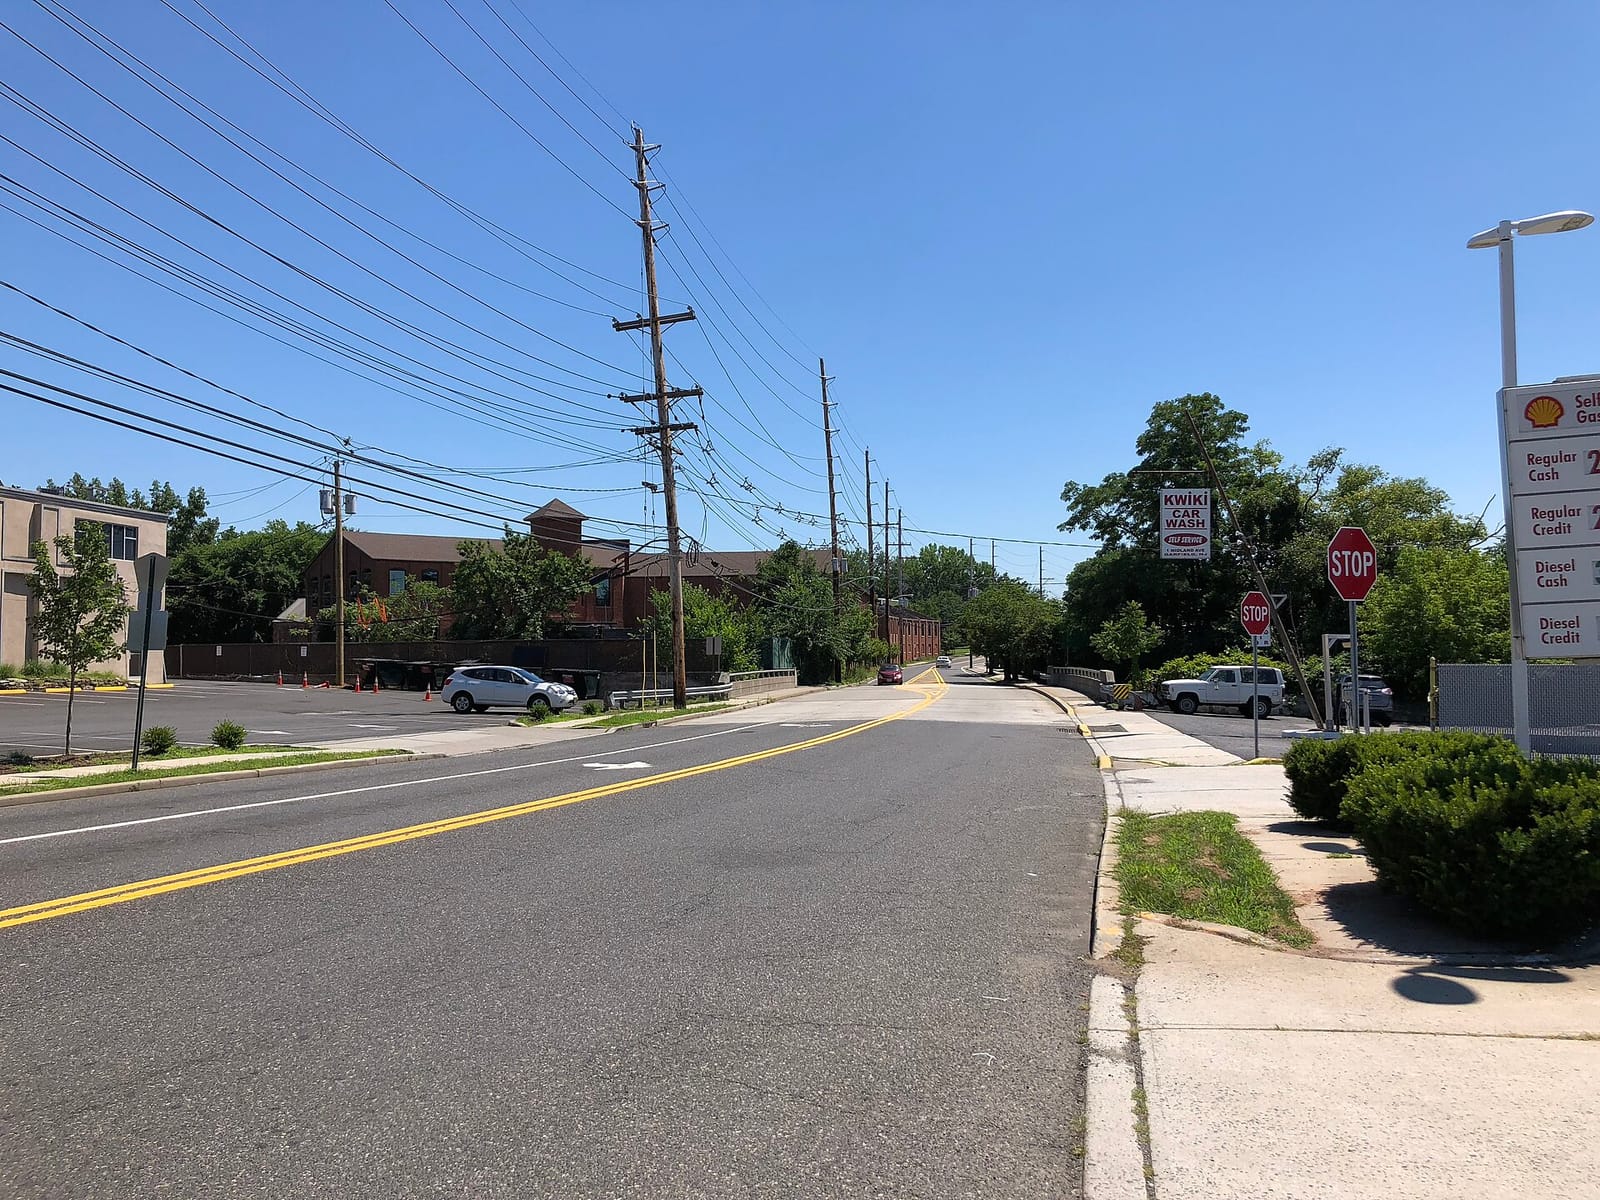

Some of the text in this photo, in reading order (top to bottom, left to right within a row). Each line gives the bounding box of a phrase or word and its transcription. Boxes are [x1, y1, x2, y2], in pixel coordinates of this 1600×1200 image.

[1527, 451, 1577, 467] Regular
[1528, 469, 1560, 482] Cash
[1172, 509, 1200, 519] CAR
[1531, 505, 1582, 521] Regular
[1166, 519, 1205, 528] WASH
[1533, 522, 1572, 536] Credit
[1168, 536, 1204, 544] SELF SERVICE
[1331, 550, 1373, 577] STOP
[1535, 559, 1575, 574] Diesel
[1537, 574, 1568, 588] Cash
[1243, 605, 1268, 622] STOP
[1540, 616, 1580, 630] Diesel
[1541, 631, 1580, 645] Credit
